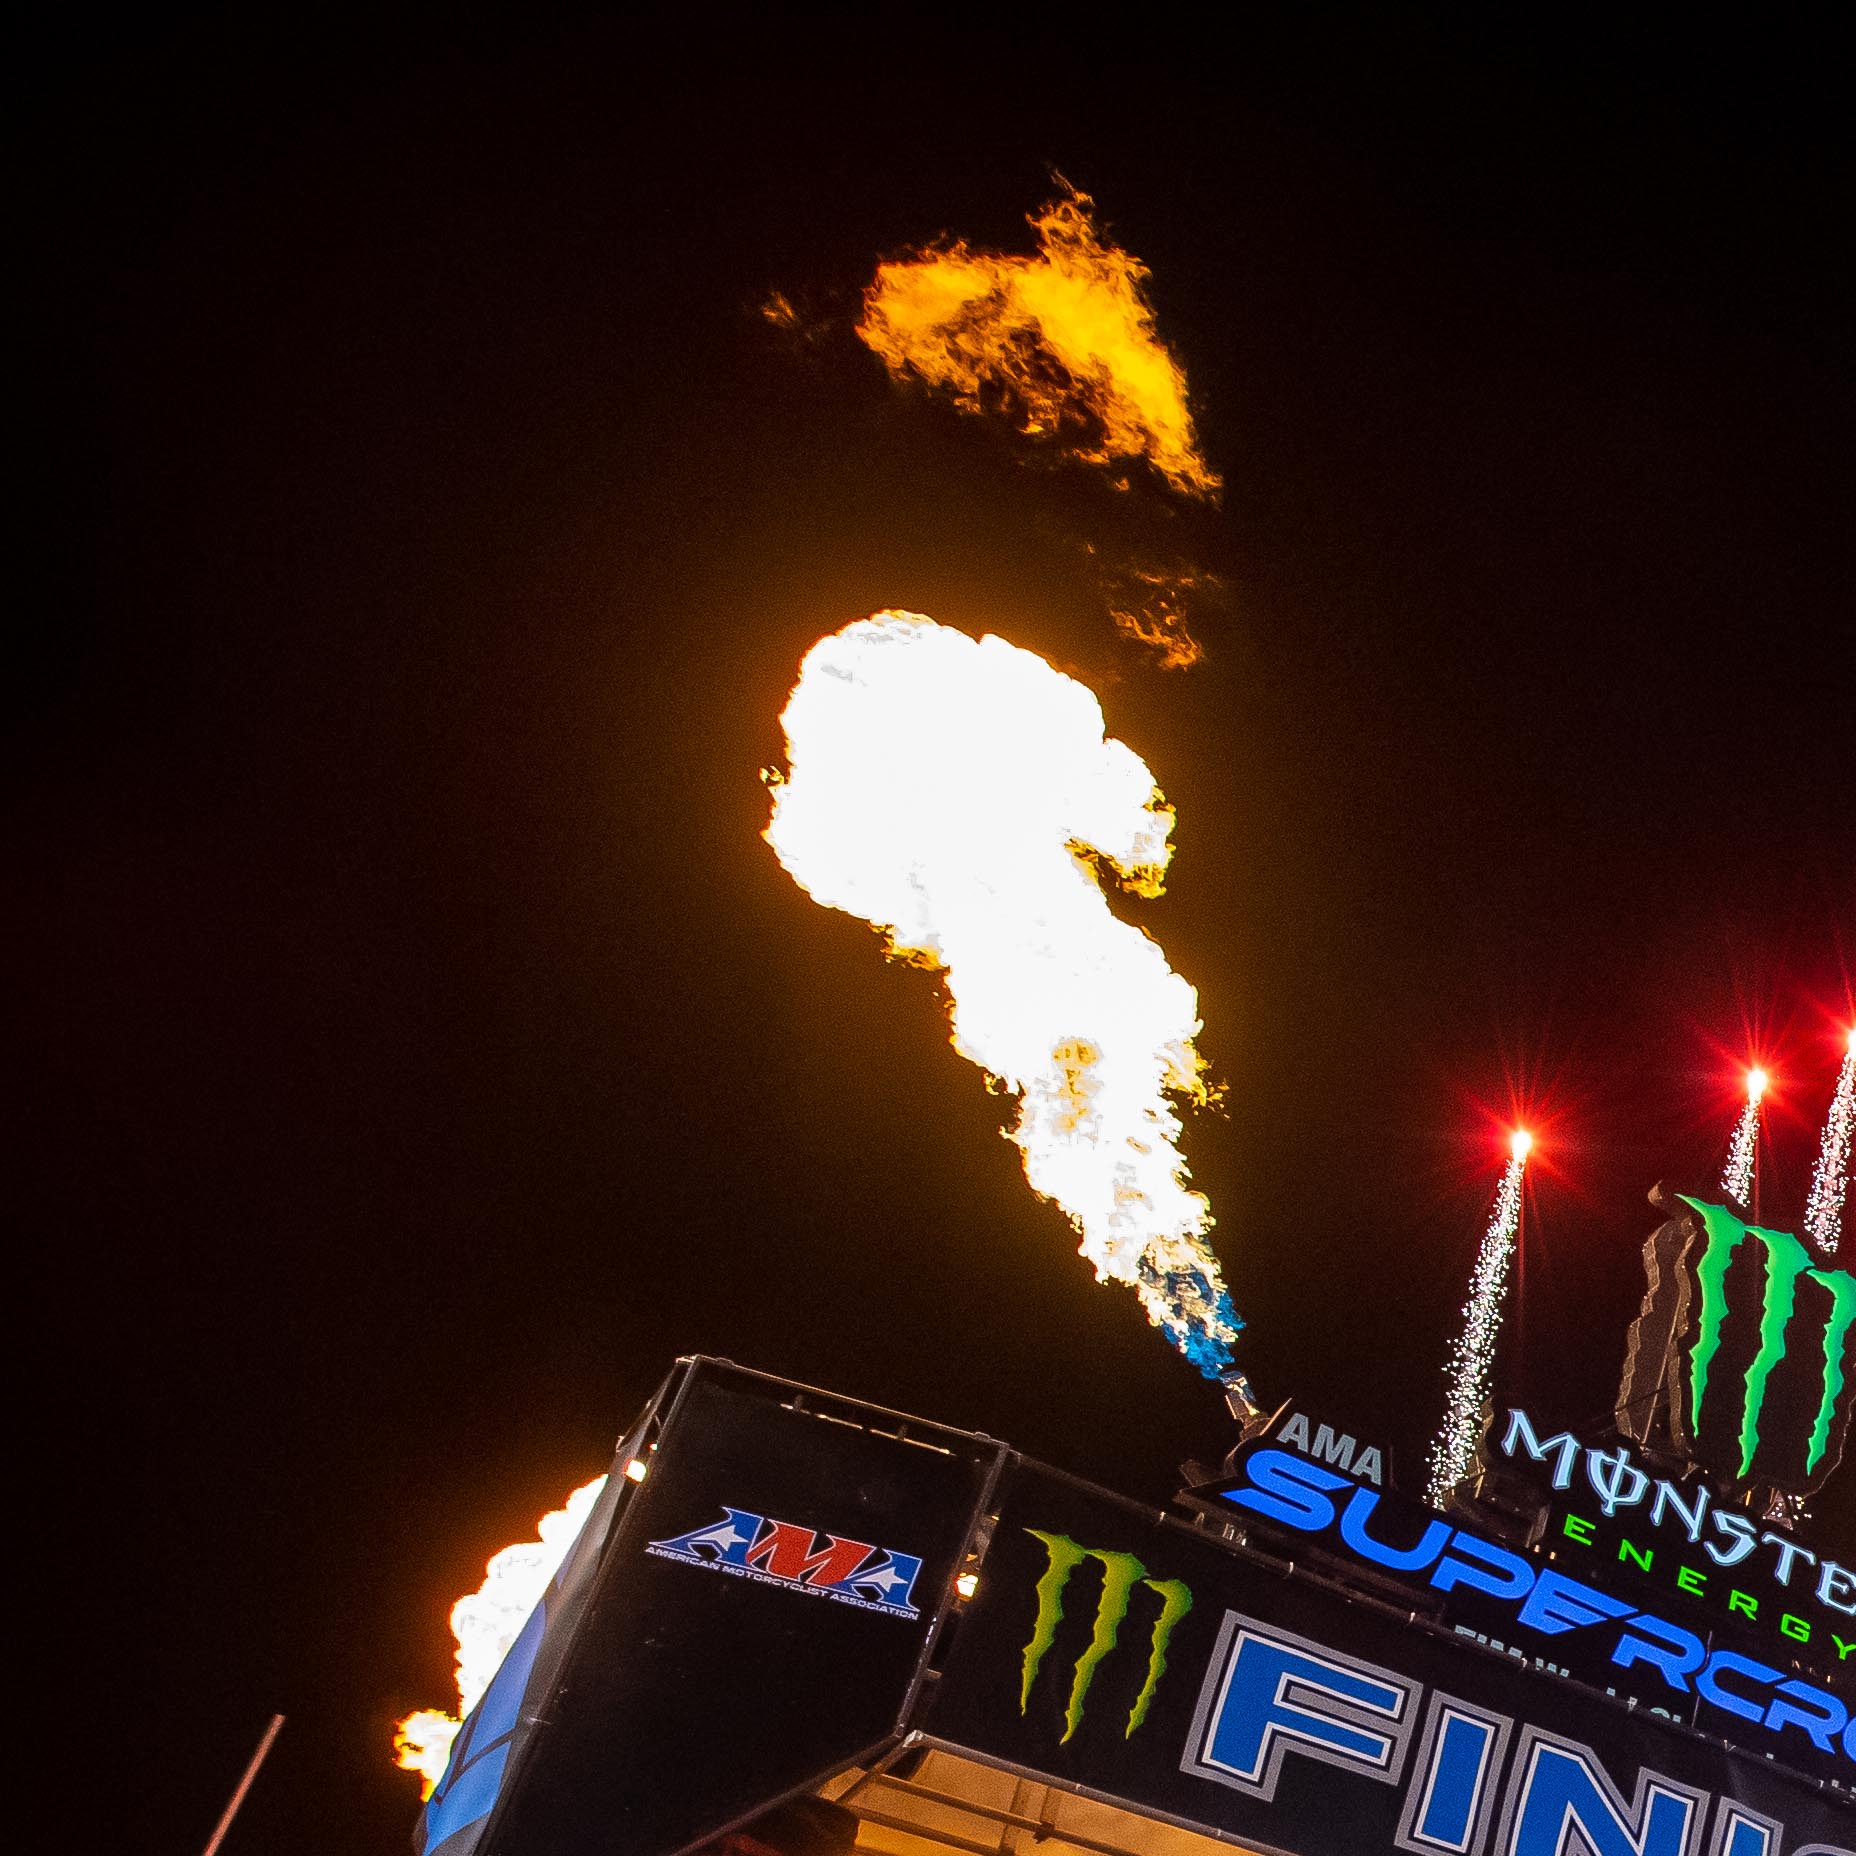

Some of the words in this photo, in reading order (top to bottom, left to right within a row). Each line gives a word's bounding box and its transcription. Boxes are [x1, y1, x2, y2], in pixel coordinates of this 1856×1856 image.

[1277, 1412, 1384, 1486] AMA
[645, 1546, 720, 1571] AMERICAN
[721, 1565, 828, 1599] MOTORCYCLIST
[829, 1593, 919, 1620] ASSOCIATION
[648, 1506, 922, 1612] AMA
